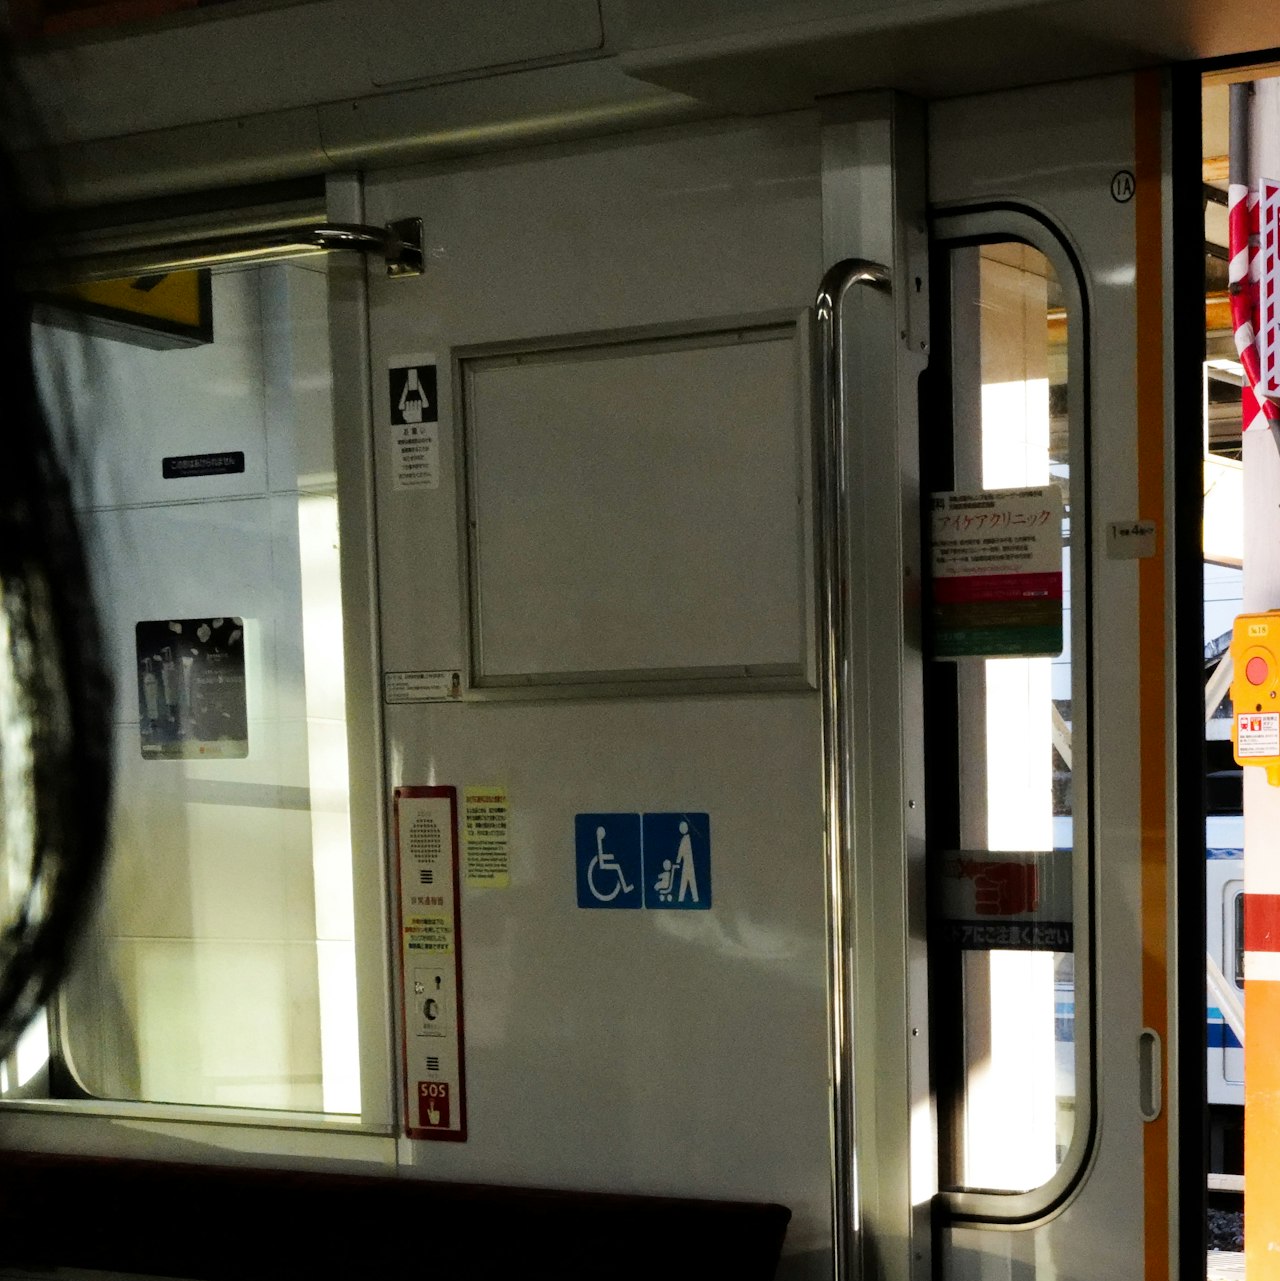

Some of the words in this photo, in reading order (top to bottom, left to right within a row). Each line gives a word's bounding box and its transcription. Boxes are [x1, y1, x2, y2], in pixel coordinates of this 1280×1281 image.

[1117, 177, 1131, 195] 1A
[938, 510, 1051, 530] アイケアクリニック
[420, 1084, 446, 1098] SOS
